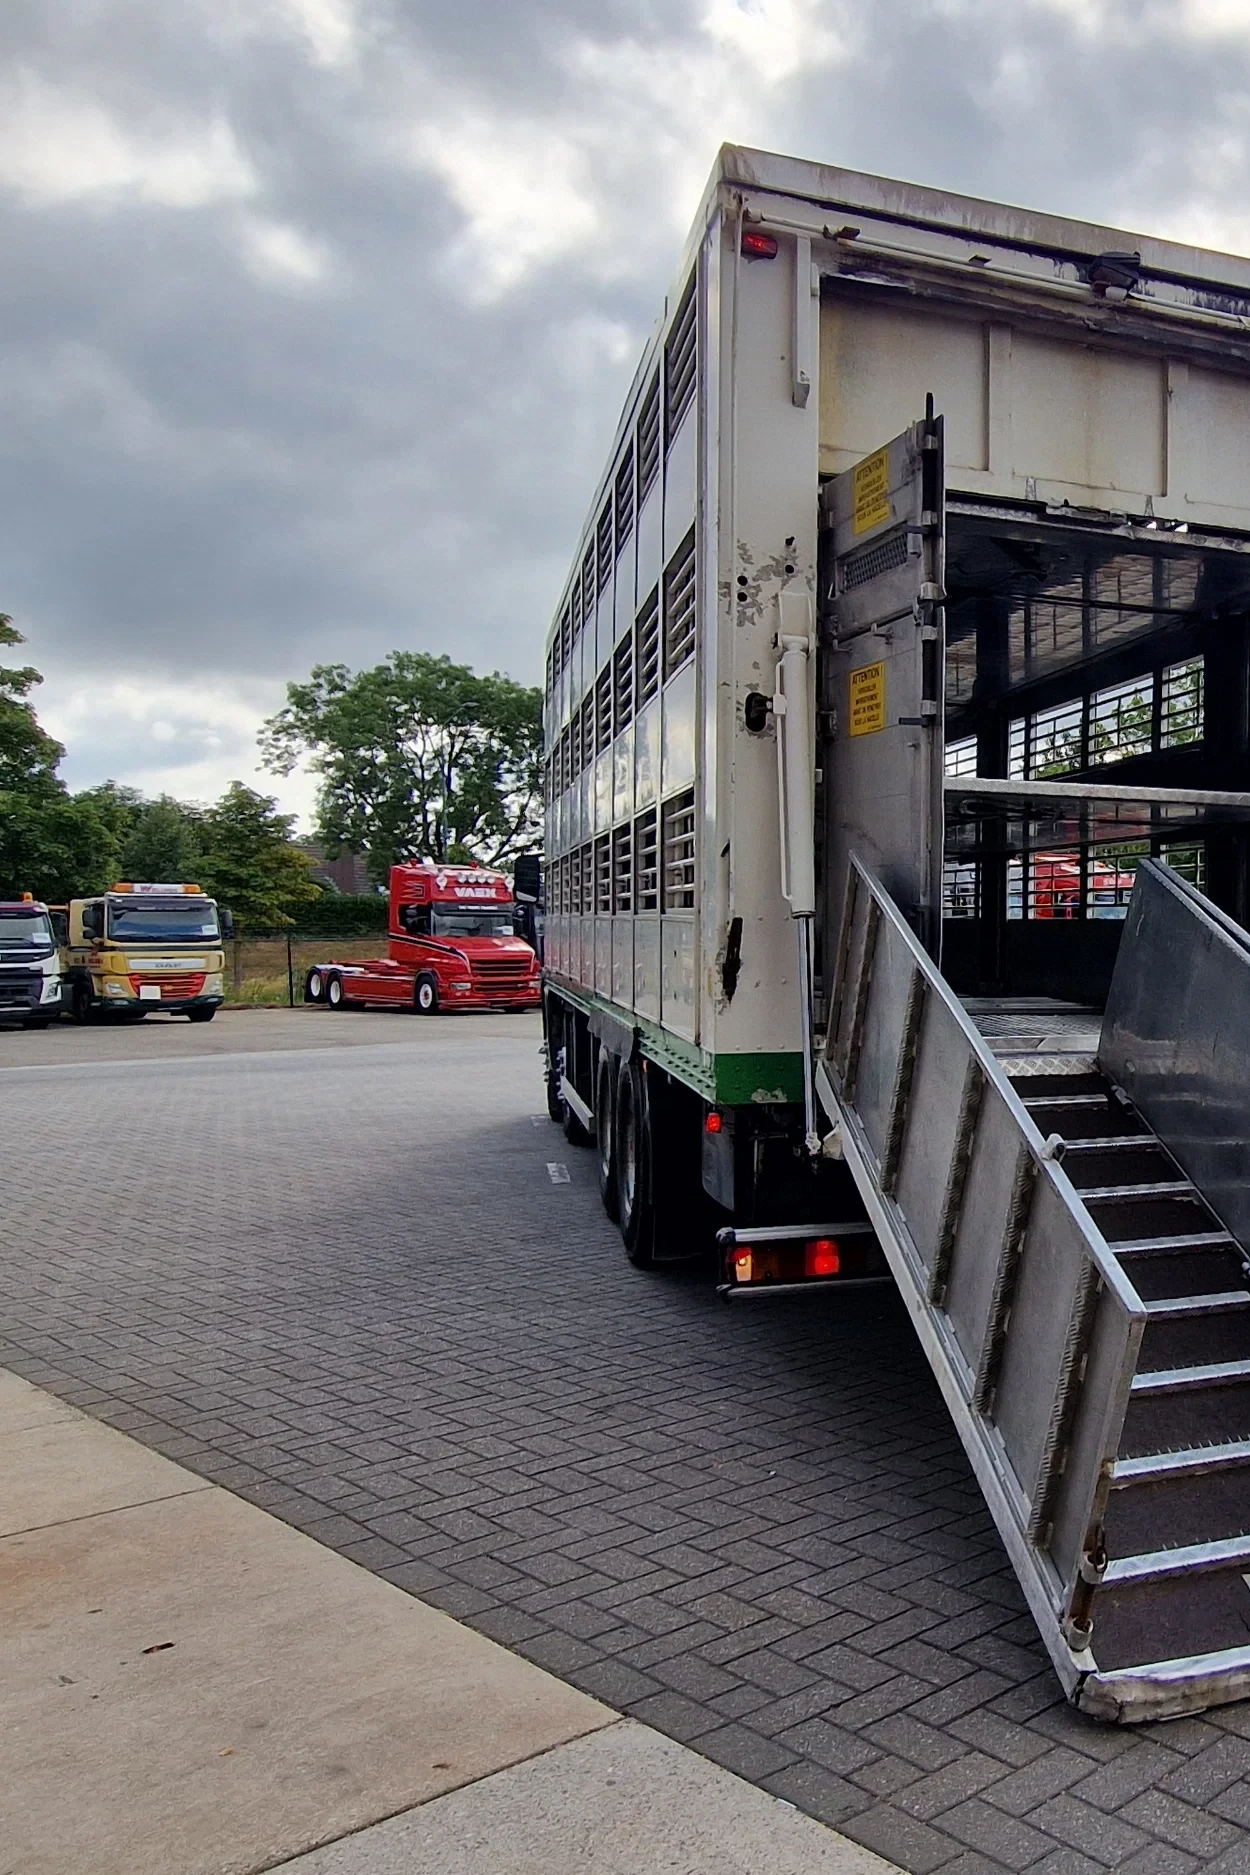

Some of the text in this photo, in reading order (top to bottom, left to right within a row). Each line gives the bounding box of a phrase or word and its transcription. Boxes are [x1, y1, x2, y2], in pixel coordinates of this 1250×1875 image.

[856, 458, 885, 484] ATTENTION
[852, 667, 880, 686] ATTENTION
[454, 887, 497, 898] VAEX
